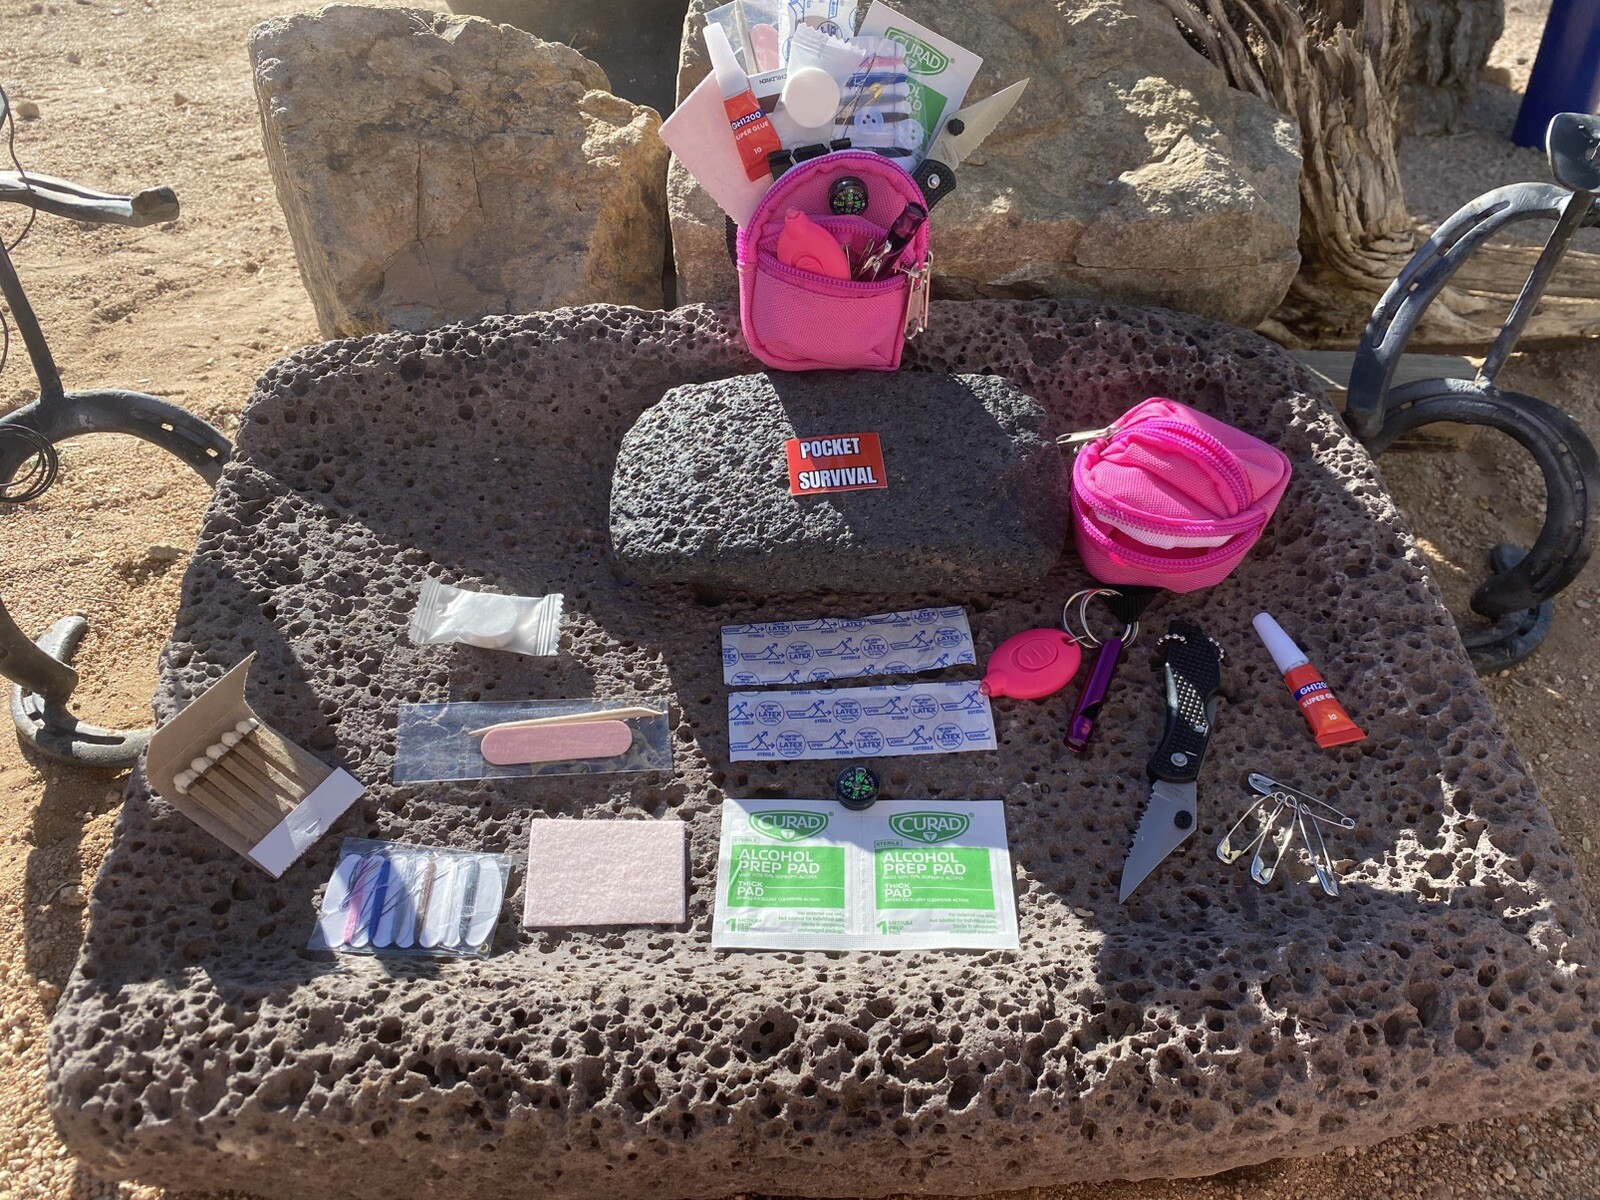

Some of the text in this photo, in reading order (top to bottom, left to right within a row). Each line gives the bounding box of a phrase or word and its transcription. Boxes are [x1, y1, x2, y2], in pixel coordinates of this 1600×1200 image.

[731, 111, 761, 130] GH1200
[736, 127, 753, 141] UPER
[800, 437, 860, 459] POCKET
[798, 466, 877, 490] SURVIVAL
[1300, 682, 1327, 695] GH120
[1302, 694, 1326, 708] SUPER
[758, 815, 820, 830] CURAD
[898, 817, 961, 832] CURAD
[739, 848, 813, 862] ALCOHOL
[883, 852, 958, 863] ALCOHOL
[740, 860, 820, 874] PREP PAD
[884, 864, 966, 875] PREP PAD
[737, 887, 764, 896] PAD
[884, 888, 912, 898] PAD
[876, 921, 887, 935] 1
